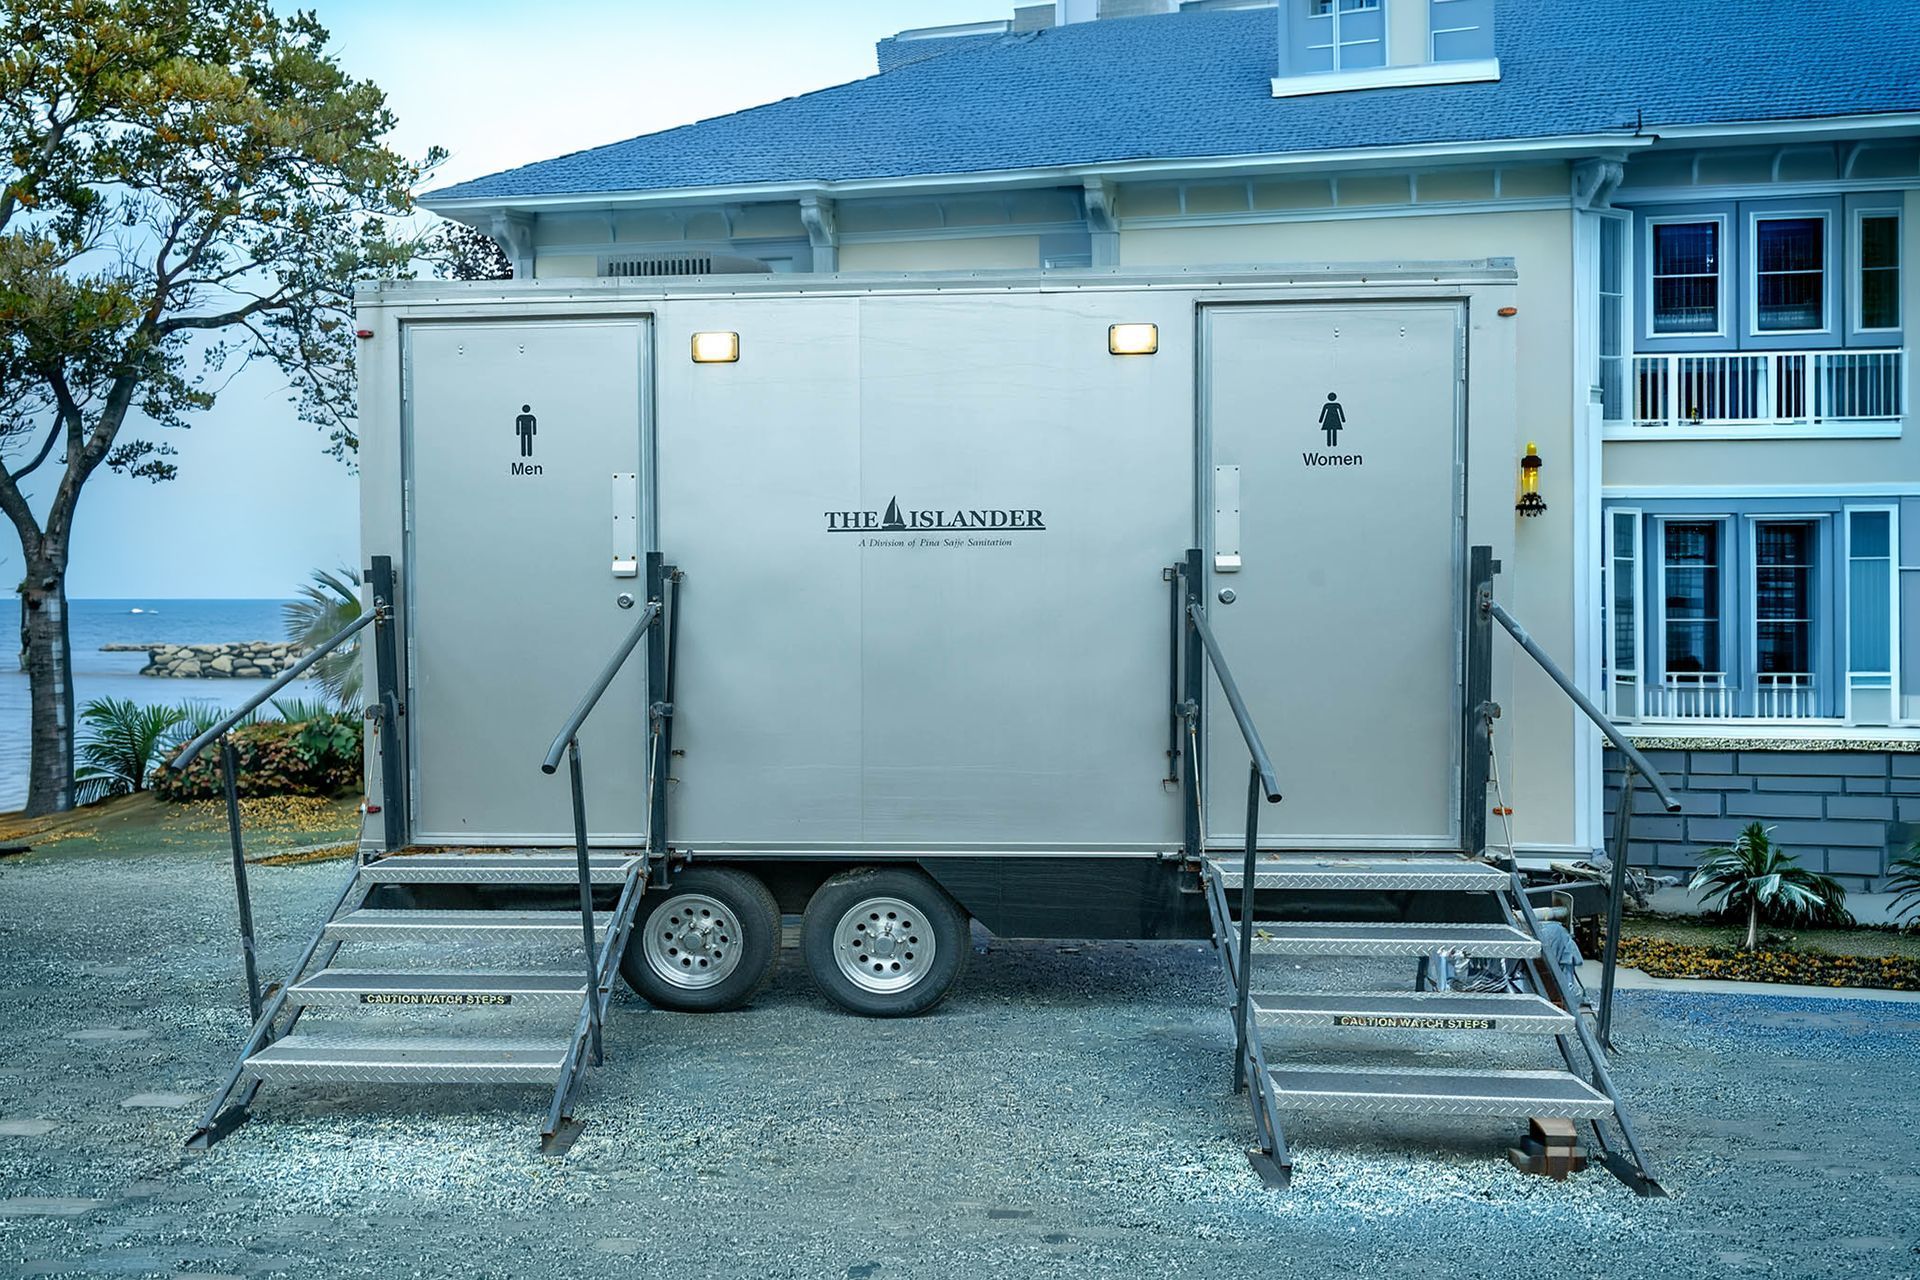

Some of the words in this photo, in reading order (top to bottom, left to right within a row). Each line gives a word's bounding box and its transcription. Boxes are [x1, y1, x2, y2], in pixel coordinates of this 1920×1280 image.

[1302, 452, 1363, 466] Women
[511, 462, 543, 476] Men
[824, 511, 878, 528] THE
[910, 509, 1046, 528] ISLANDER
[858, 538, 866, 547] A
[869, 538, 904, 547] Division
[907, 538, 917, 549] of
[967, 537, 1013, 547] Sanitation
[366, 994, 420, 1004] CAUTION
[421, 994, 463, 1004] WATCH
[466, 994, 505, 1004] STEPS
[1340, 1016, 1397, 1028] CAUTION
[1399, 1018, 1444, 1028] WATCH
[1448, 1019, 1489, 1029] STEPS
